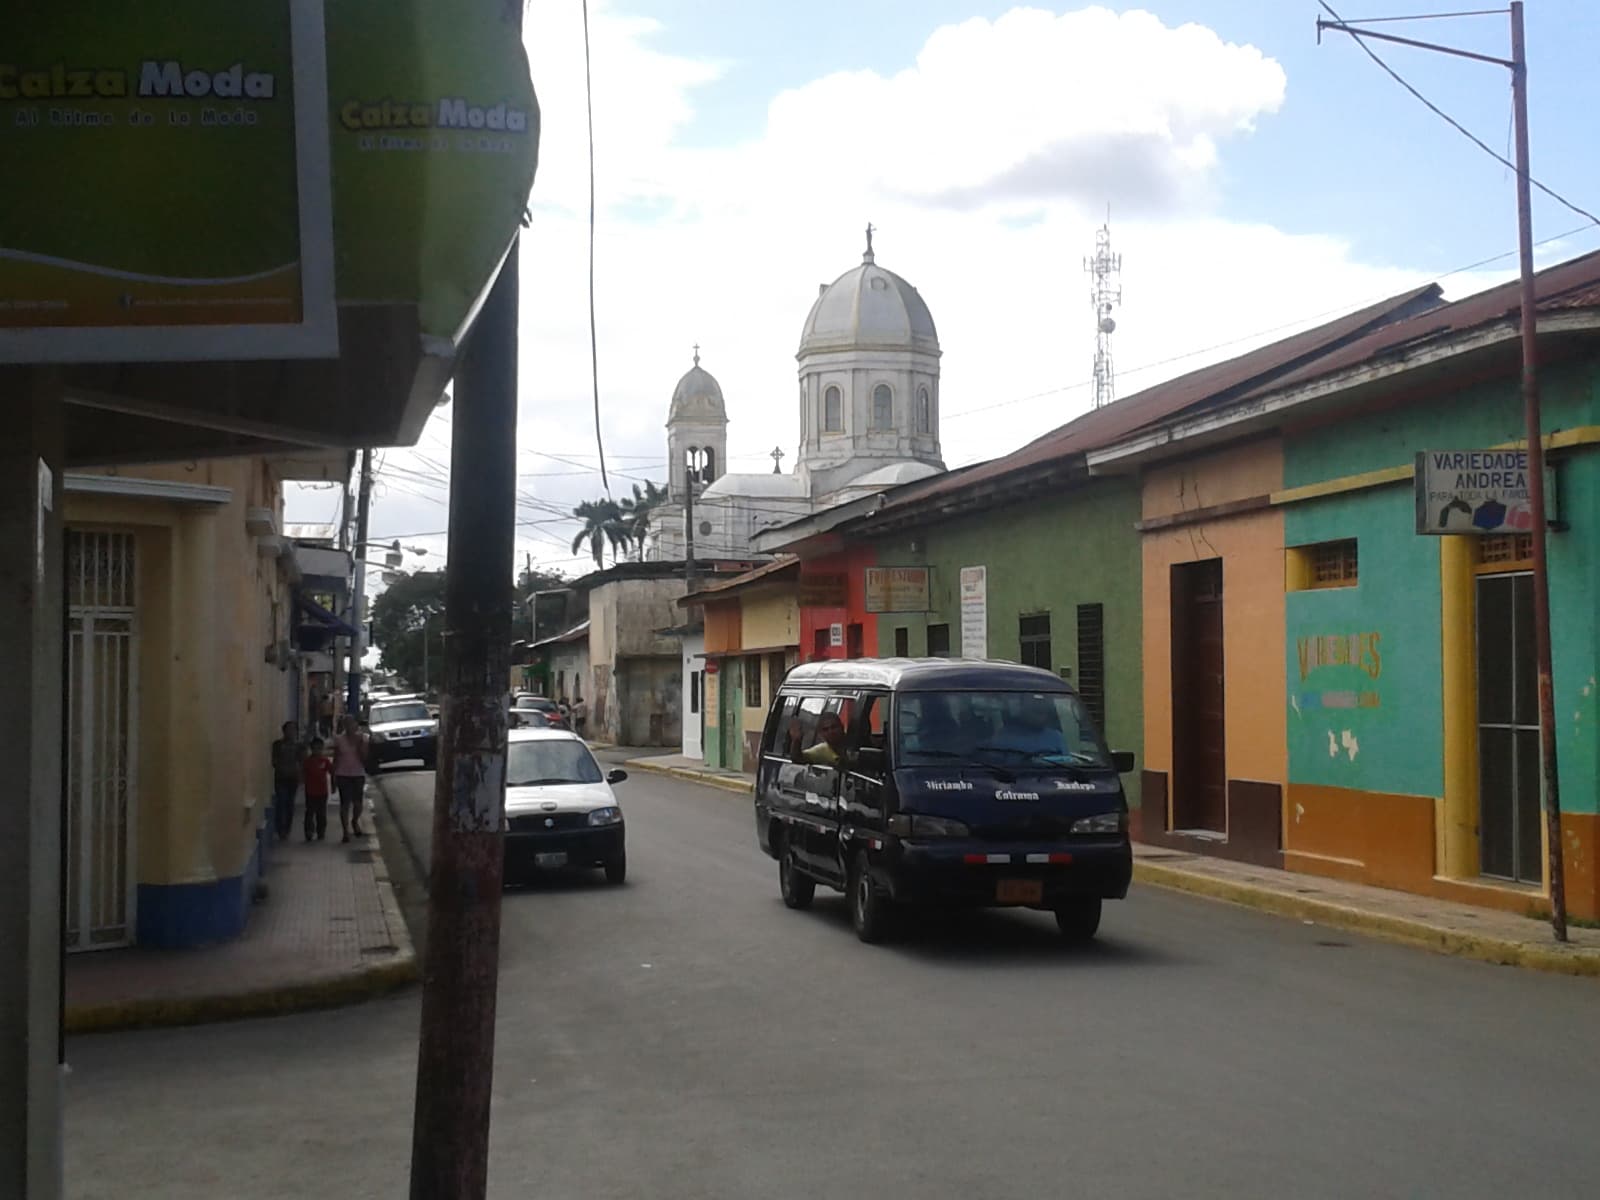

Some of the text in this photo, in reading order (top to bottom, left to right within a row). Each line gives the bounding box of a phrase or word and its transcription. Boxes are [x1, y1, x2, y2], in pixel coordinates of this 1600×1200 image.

[139, 61, 274, 98] Moda
[438, 98, 527, 132] Moda
[1433, 453, 1529, 471] VARIEDADE
[1455, 472, 1526, 489] ANDREA
